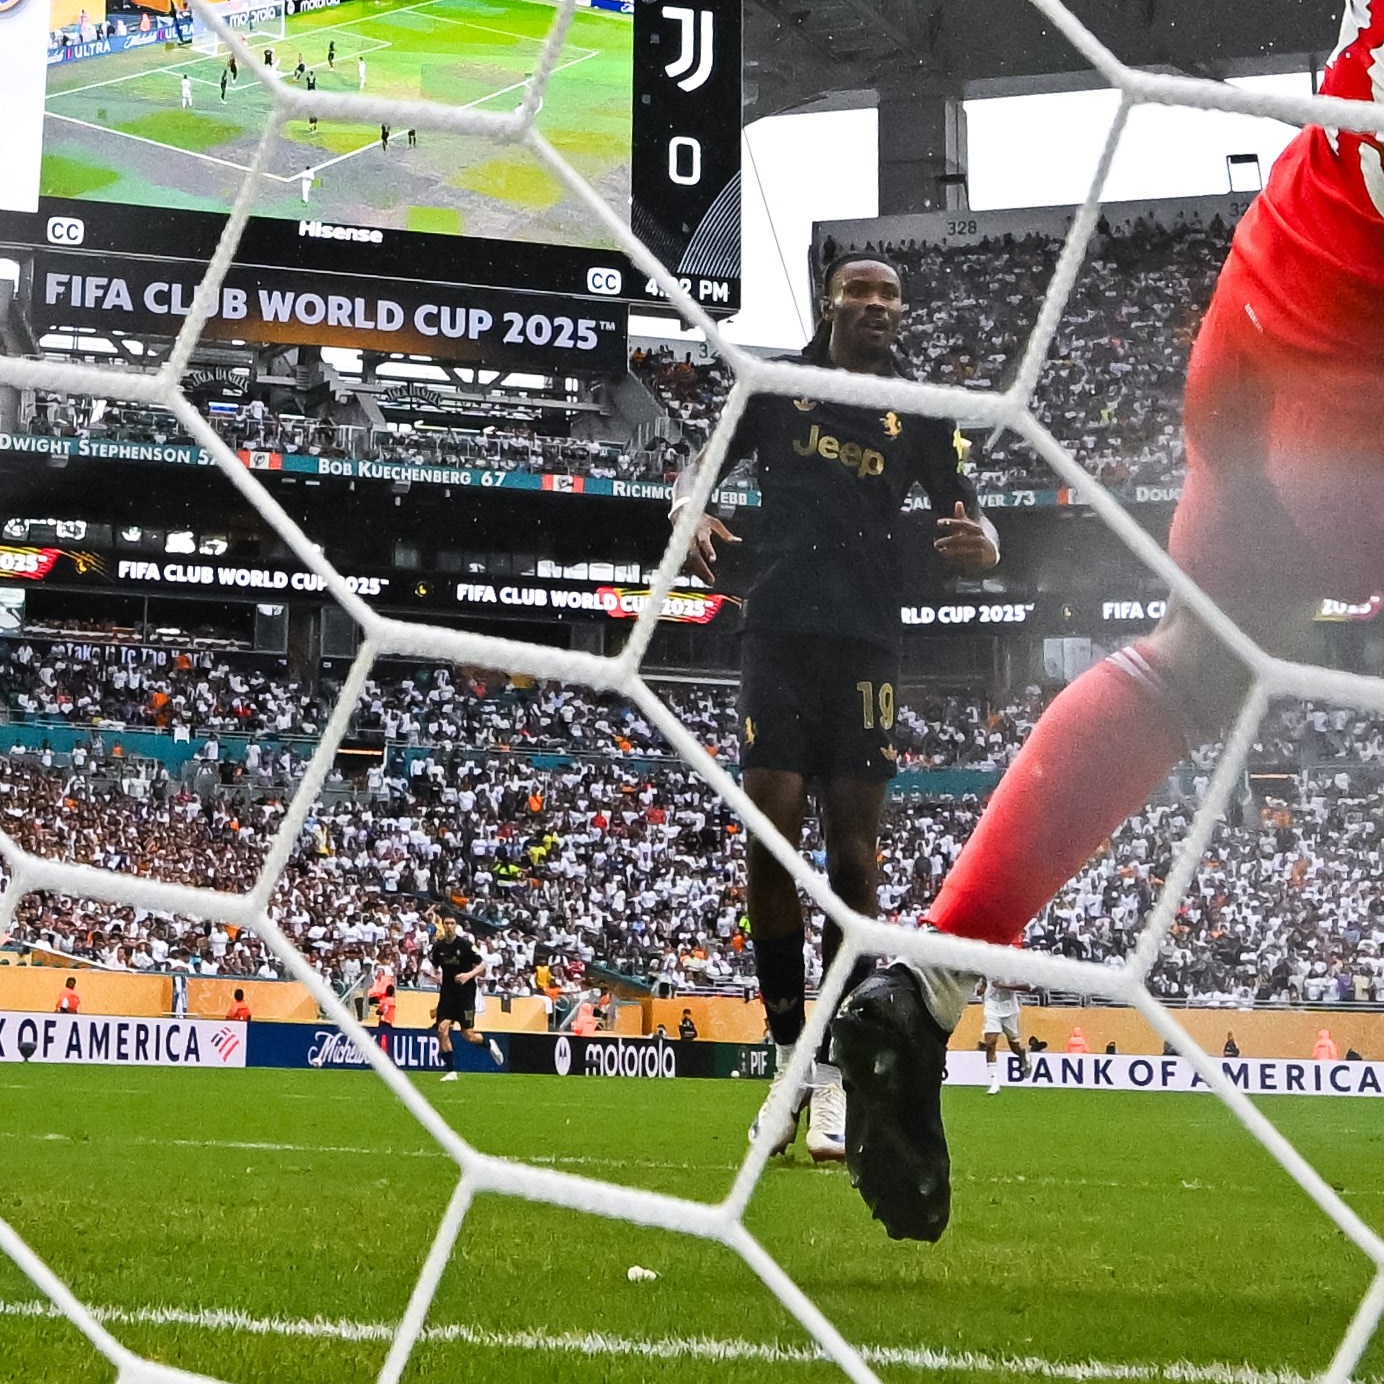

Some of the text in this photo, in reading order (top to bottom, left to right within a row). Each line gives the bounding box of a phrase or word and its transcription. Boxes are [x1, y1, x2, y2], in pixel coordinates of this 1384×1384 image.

[74, 41, 111, 58] ULTRA
[669, 138, 702, 186] 0
[51, 222, 79, 240] CC
[298, 220, 384, 243] Hisense
[948, 221, 976, 235] 328
[591, 272, 617, 290] CC
[699, 280, 729, 303] PM
[45, 272, 134, 312] FIFA
[257, 290, 404, 332] WORLD
[414, 304, 493, 340] CUP
[79, 439, 190, 464] STEPHENSON
[793, 425, 885, 479] Jeep
[318, 458, 507, 487] BOB KUECHENBERG 67
[1011, 490, 1035, 506] 73
[118, 560, 161, 581] FIFA
[163, 564, 214, 585] CLUB
[218, 568, 289, 589] WORLD
[457, 583, 498, 603] FIFA
[500, 586, 547, 606] CLUB
[551, 590, 617, 611] WORLD
[938, 604, 976, 623] CUP
[1102, 602, 1144, 620] FIFA
[856, 680, 894, 730] 19
[18, 1018, 57, 1059] OF
[65, 1021, 200, 1062] AMERICA
[585, 1038, 676, 1078] motorola
[750, 1050, 768, 1075] PIF
[1007, 1056, 1113, 1085] BANK
[1128, 1060, 1176, 1087] OF
